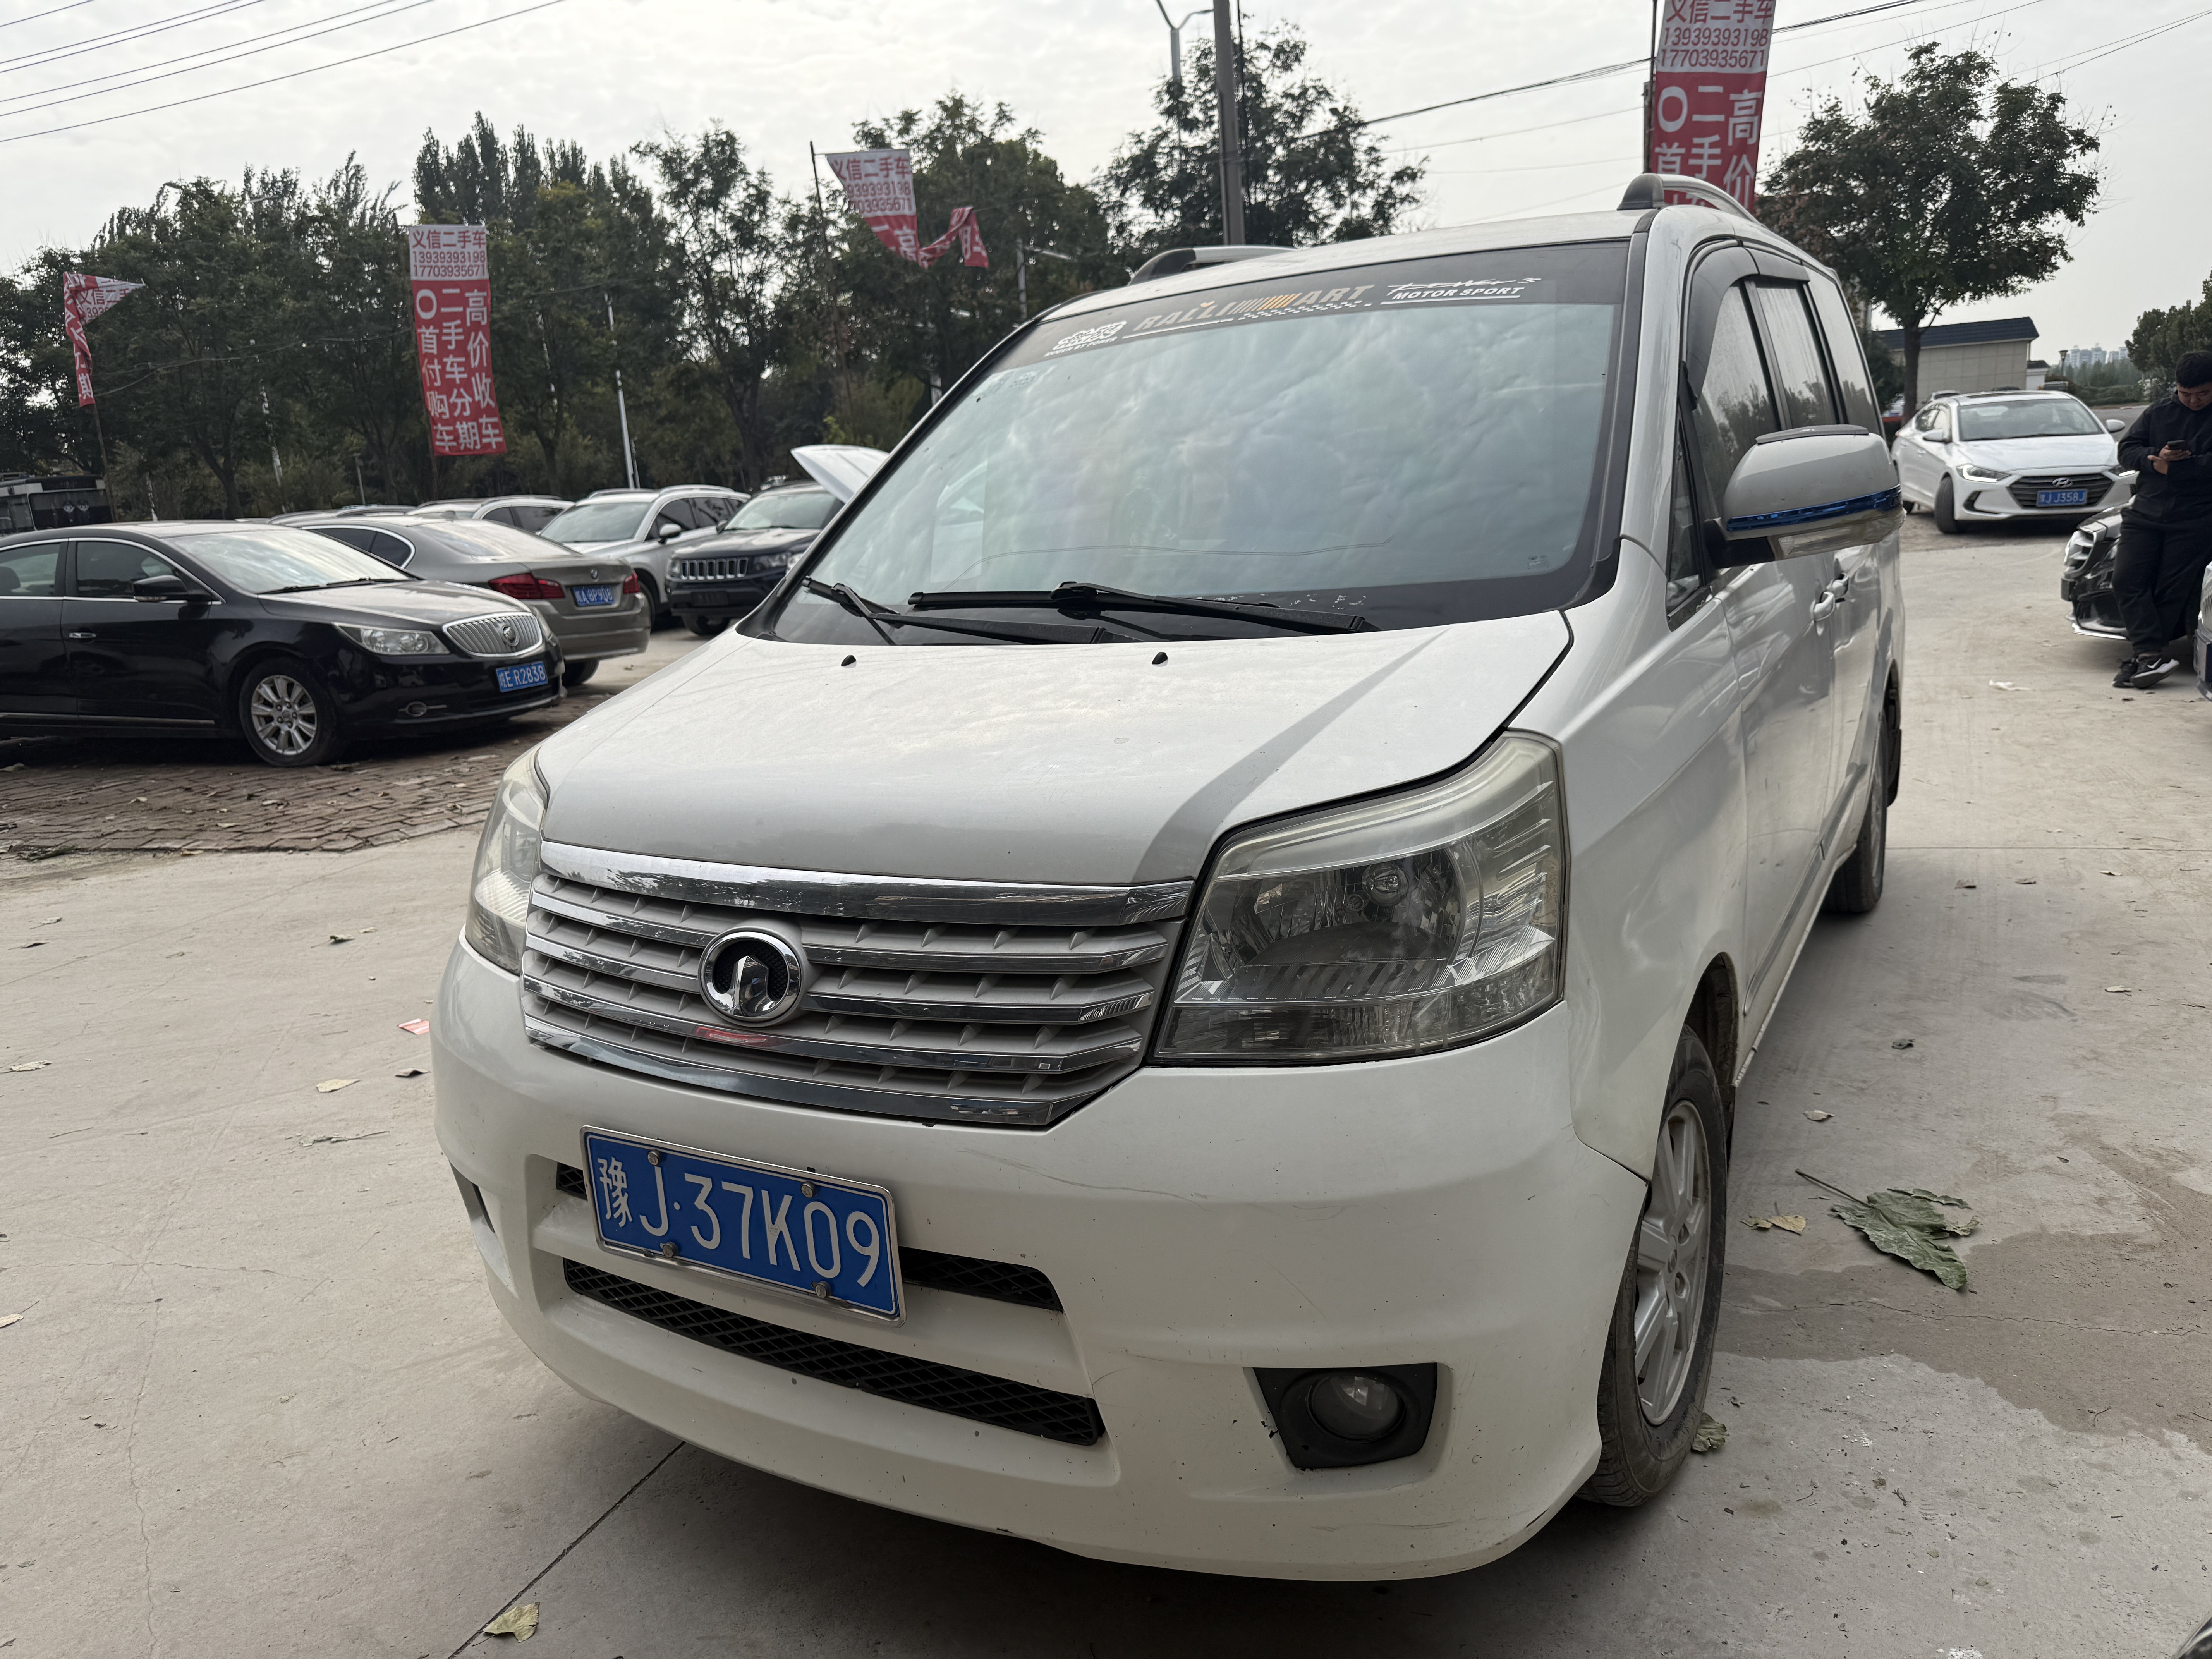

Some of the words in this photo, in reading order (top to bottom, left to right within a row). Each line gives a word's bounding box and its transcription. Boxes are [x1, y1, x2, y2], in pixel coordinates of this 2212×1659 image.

[1666, 0, 1772, 24] 义信二手车
[1664, 27, 1769, 46] 13939393198
[1661, 49, 1764, 68] 17703935671
[412, 229, 486, 249] 义信二手车
[413, 251, 486, 264] 13939393198
[414, 264, 485, 277] 17703935671
[1391, 289, 1458, 300] MOTOR
[1459, 287, 1525, 296] SPORT
[440, 288, 481, 450] 二手车分期
[465, 289, 503, 449] 高价收车
[598, 1157, 880, 1287] 豫J·37K09
